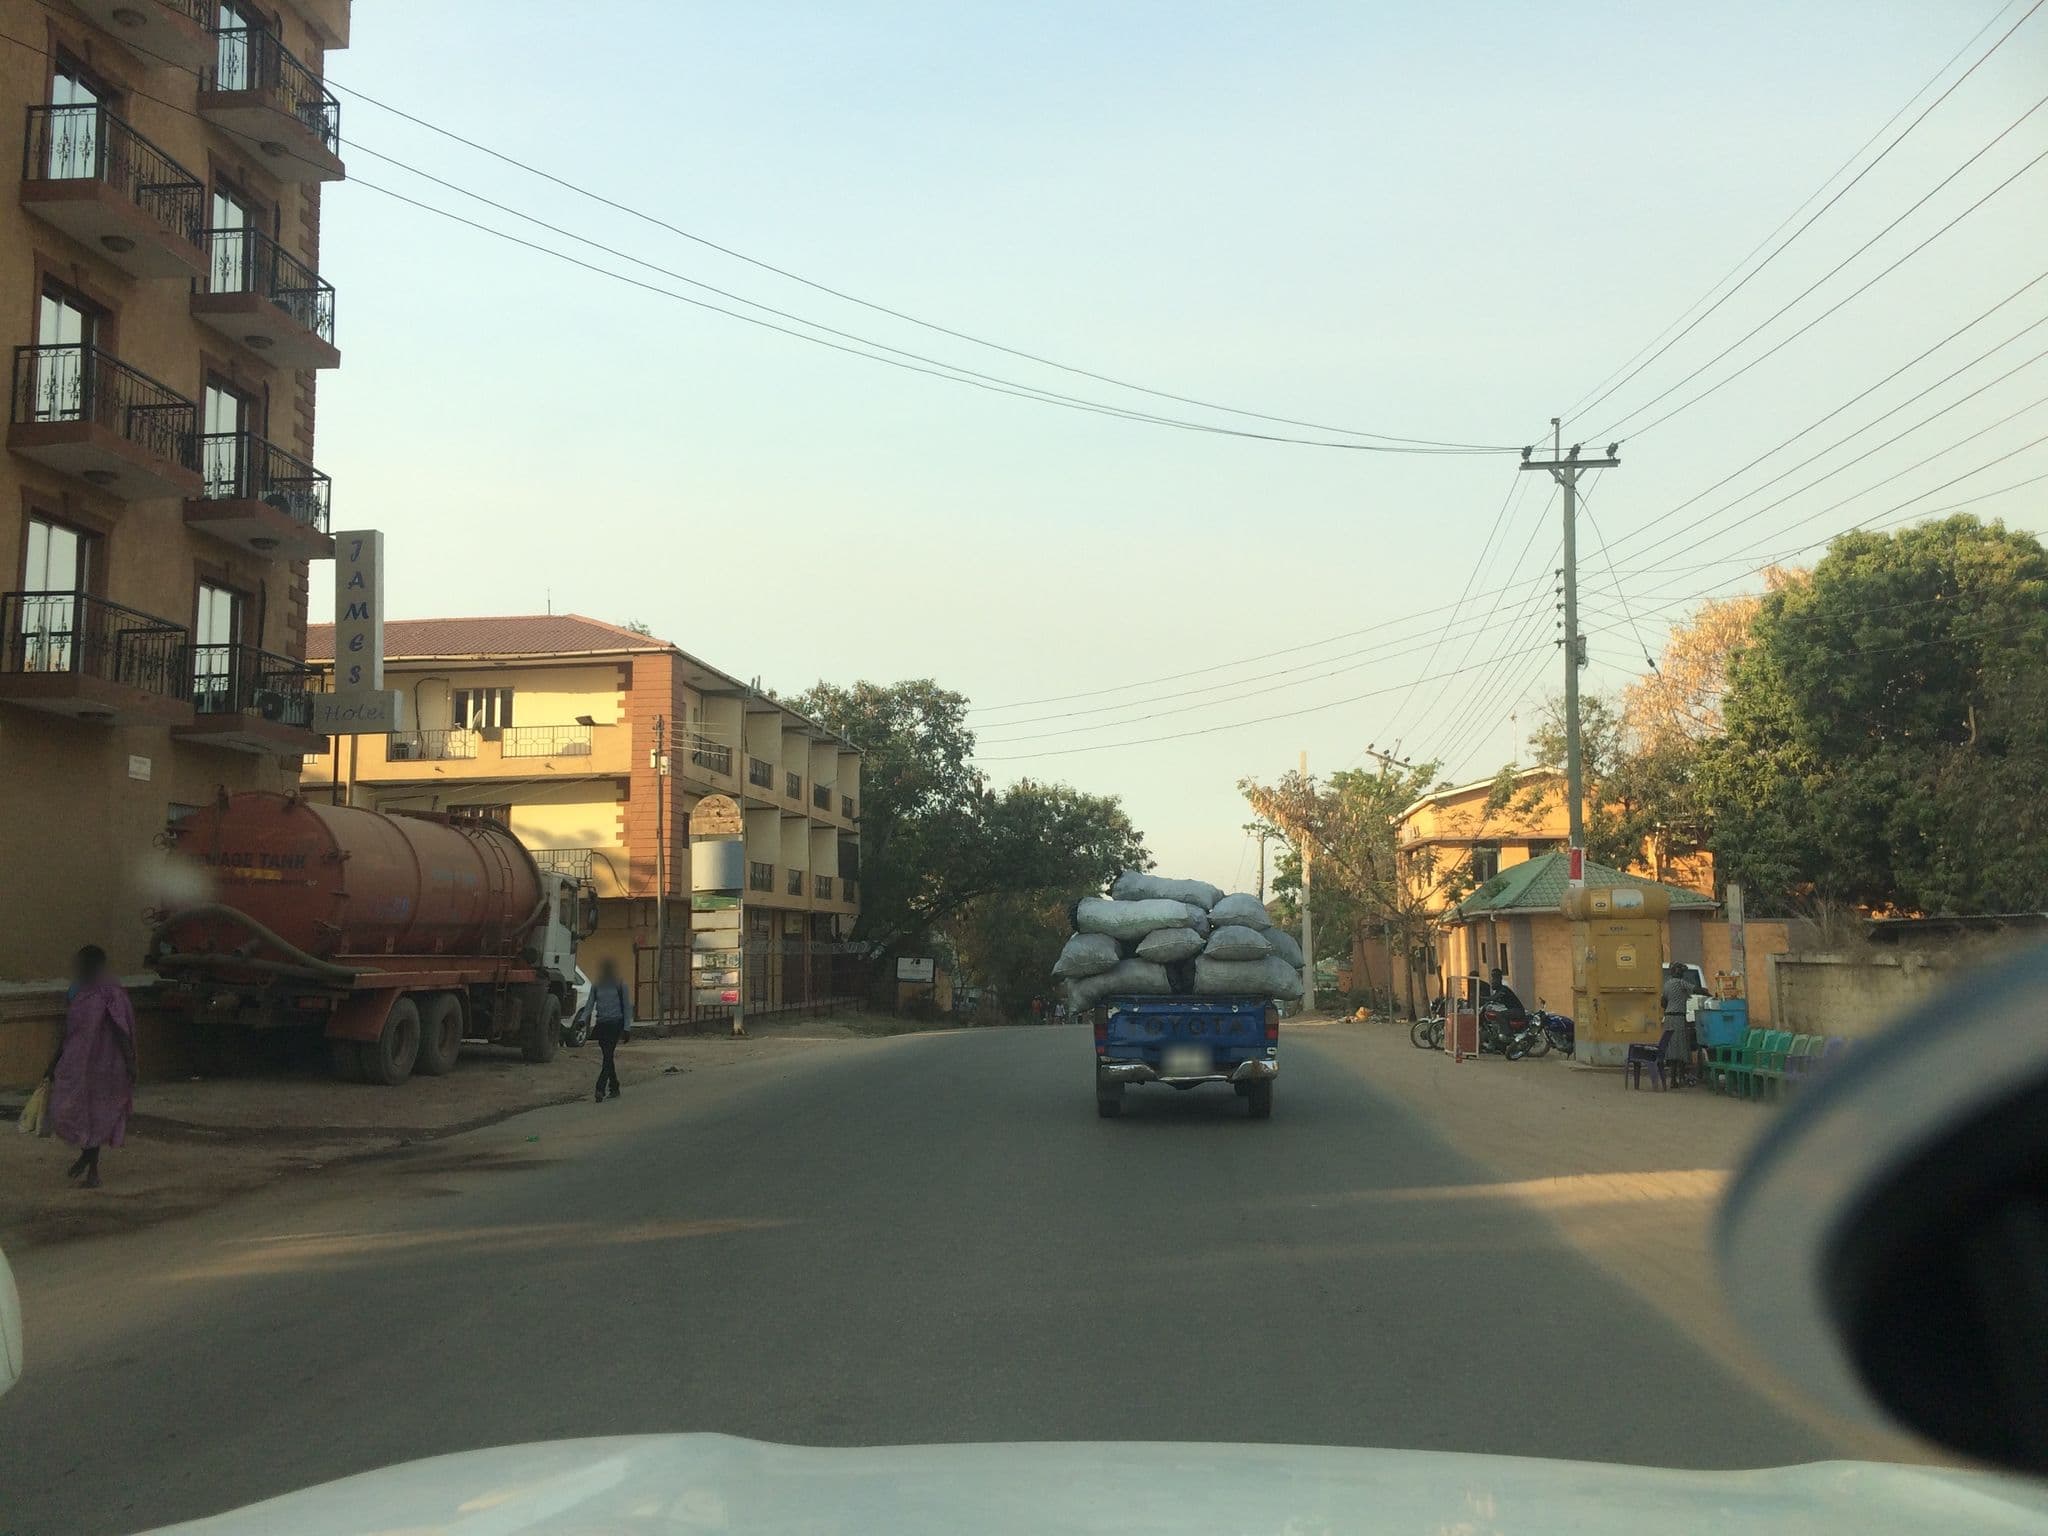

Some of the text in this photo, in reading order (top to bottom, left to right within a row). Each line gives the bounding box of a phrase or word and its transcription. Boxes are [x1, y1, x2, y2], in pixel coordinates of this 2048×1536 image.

[344, 539, 370, 685] JAMES
[323, 701, 386, 722] Hotel
[189, 852, 253, 868] EWAGE
[1124, 1015, 1243, 1036] TOYOTA
